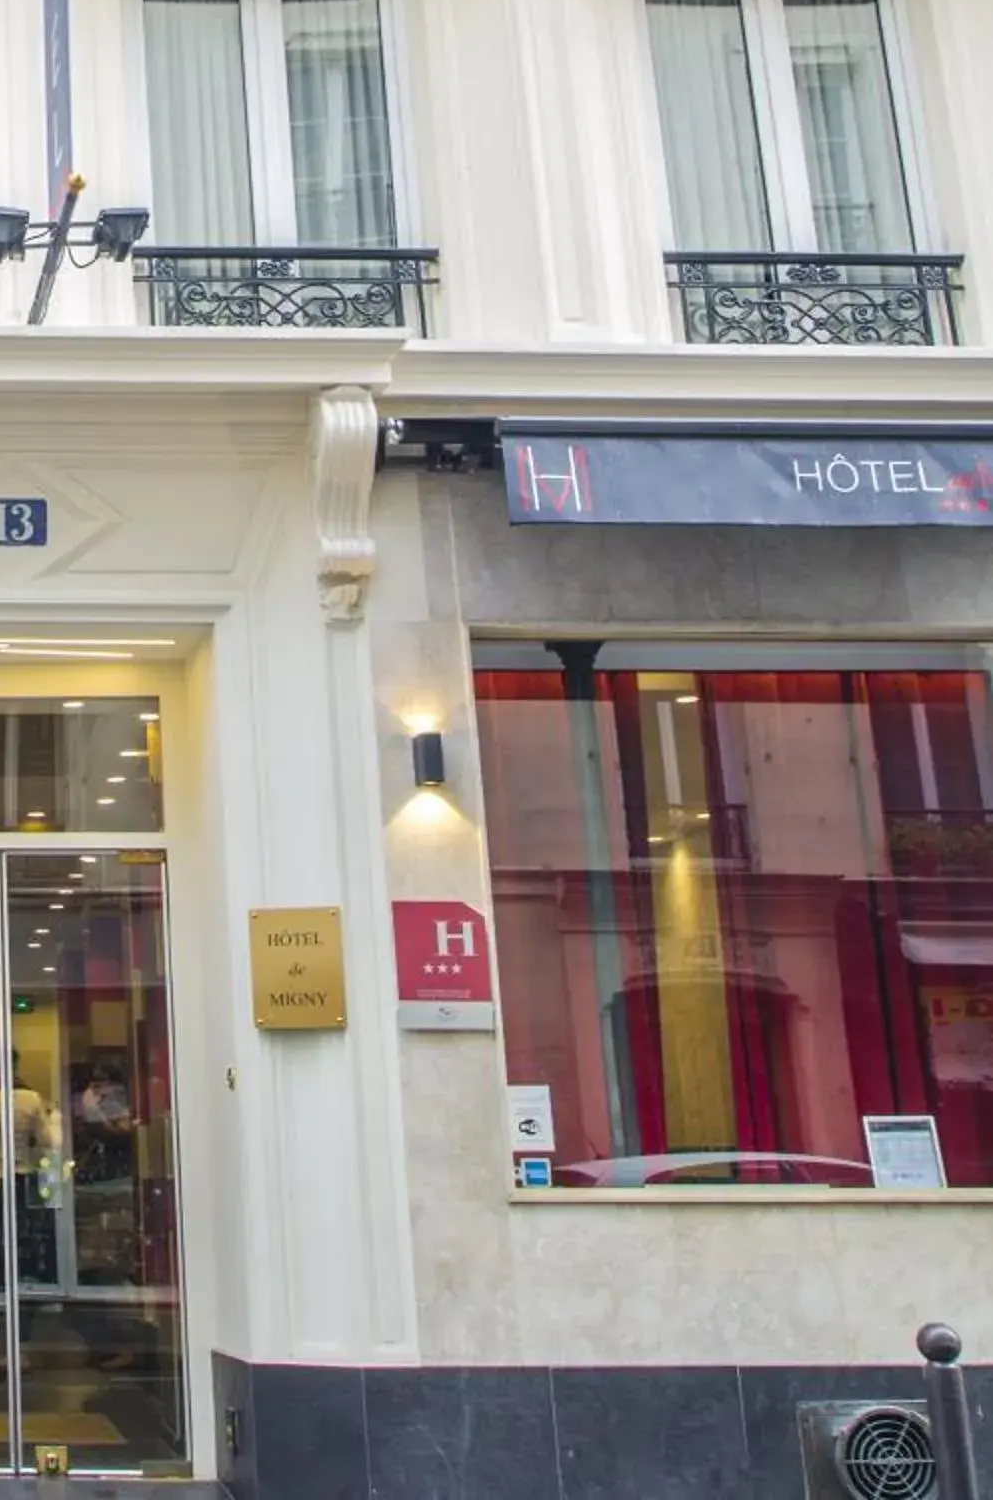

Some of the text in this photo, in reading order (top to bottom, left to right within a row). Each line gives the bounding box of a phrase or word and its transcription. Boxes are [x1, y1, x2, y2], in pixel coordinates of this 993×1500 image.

[792, 452, 944, 493] HÔTEL
[267, 929, 324, 947] HÔTEL
[432, 918, 480, 957] H
[288, 962, 306, 978] de
[269, 993, 328, 1009] MIGNY
